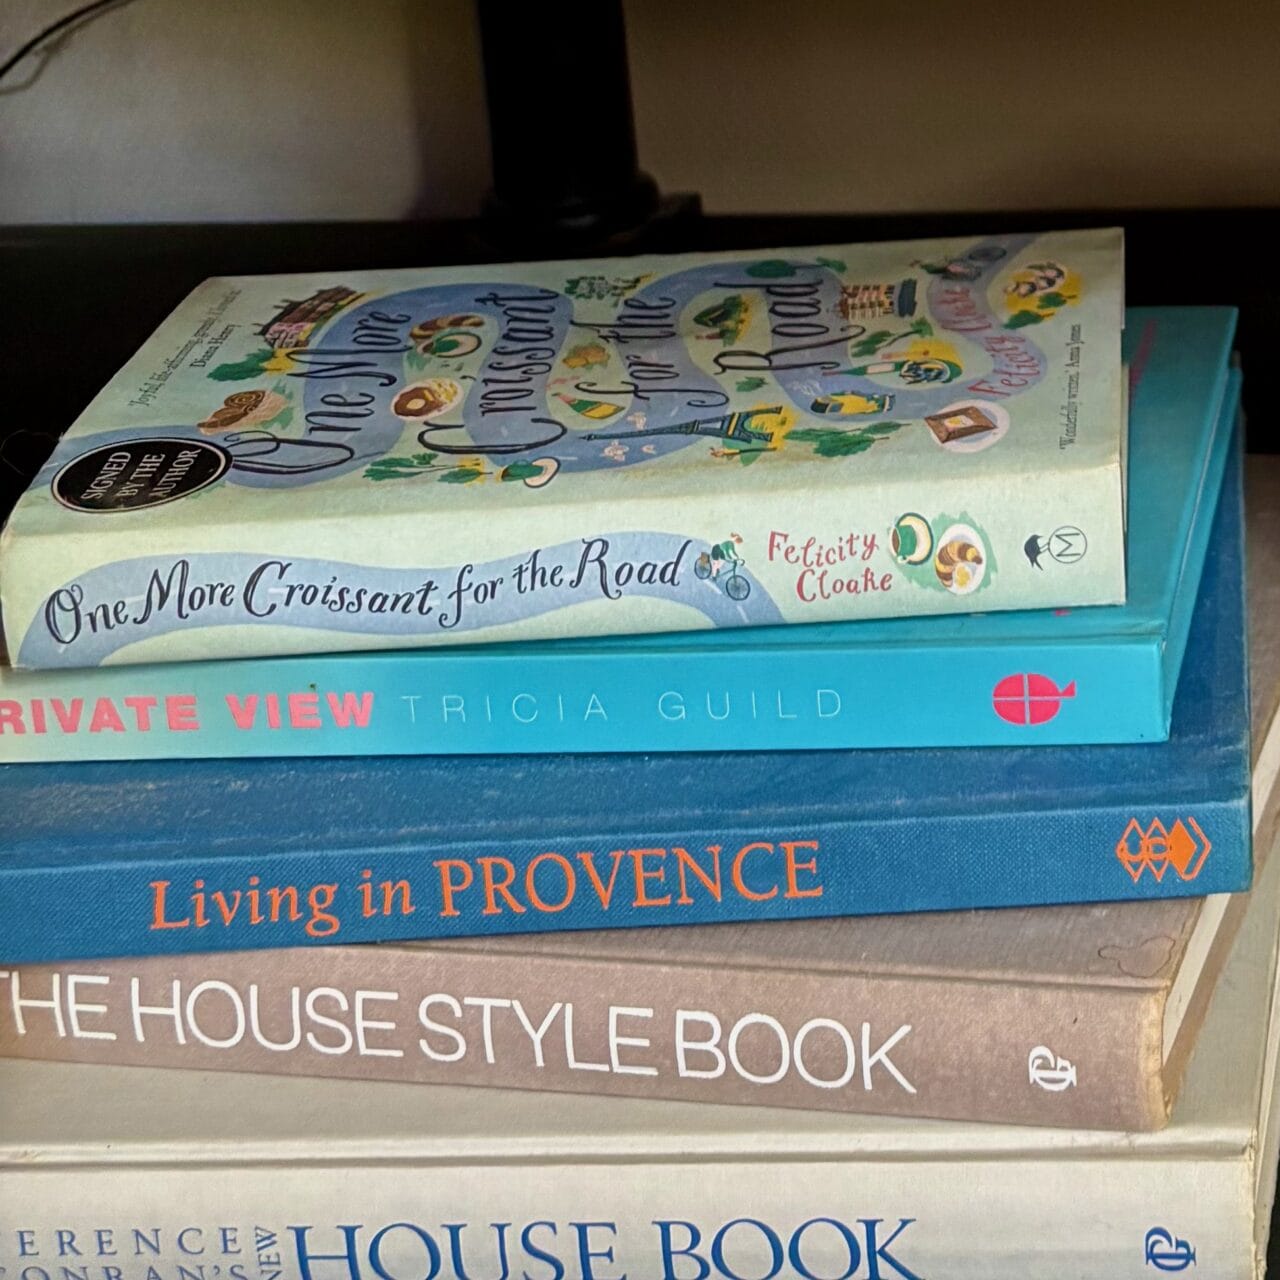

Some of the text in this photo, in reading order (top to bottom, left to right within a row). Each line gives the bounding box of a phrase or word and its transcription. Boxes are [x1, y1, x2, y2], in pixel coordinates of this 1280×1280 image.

[574, 295, 730, 409] for the
[713, 276, 867, 378] Road
[223, 309, 413, 475] One More
[415, 286, 569, 455] Croissant
[80, 451, 132, 500] SIGNED
[116, 452, 166, 498] BY THE
[150, 447, 202, 499] AUTHOR
[767, 529, 881, 569] Felicity
[44, 538, 692, 645] One More Croissant for the Road
[796, 566, 894, 602] Cloake
[0, 688, 842, 735] RIVATE VIEW TRICIA GUILD
[149, 839, 825, 938] Living in PROVENCE
[0, 970, 917, 1095] HE HOUSE STYLE BOOK
[17, 1226, 242, 1257] ERENCE
[286, 1218, 926, 1280] HOUSE BOOK
[0, 1264, 248, 1280] ONRAN'S
